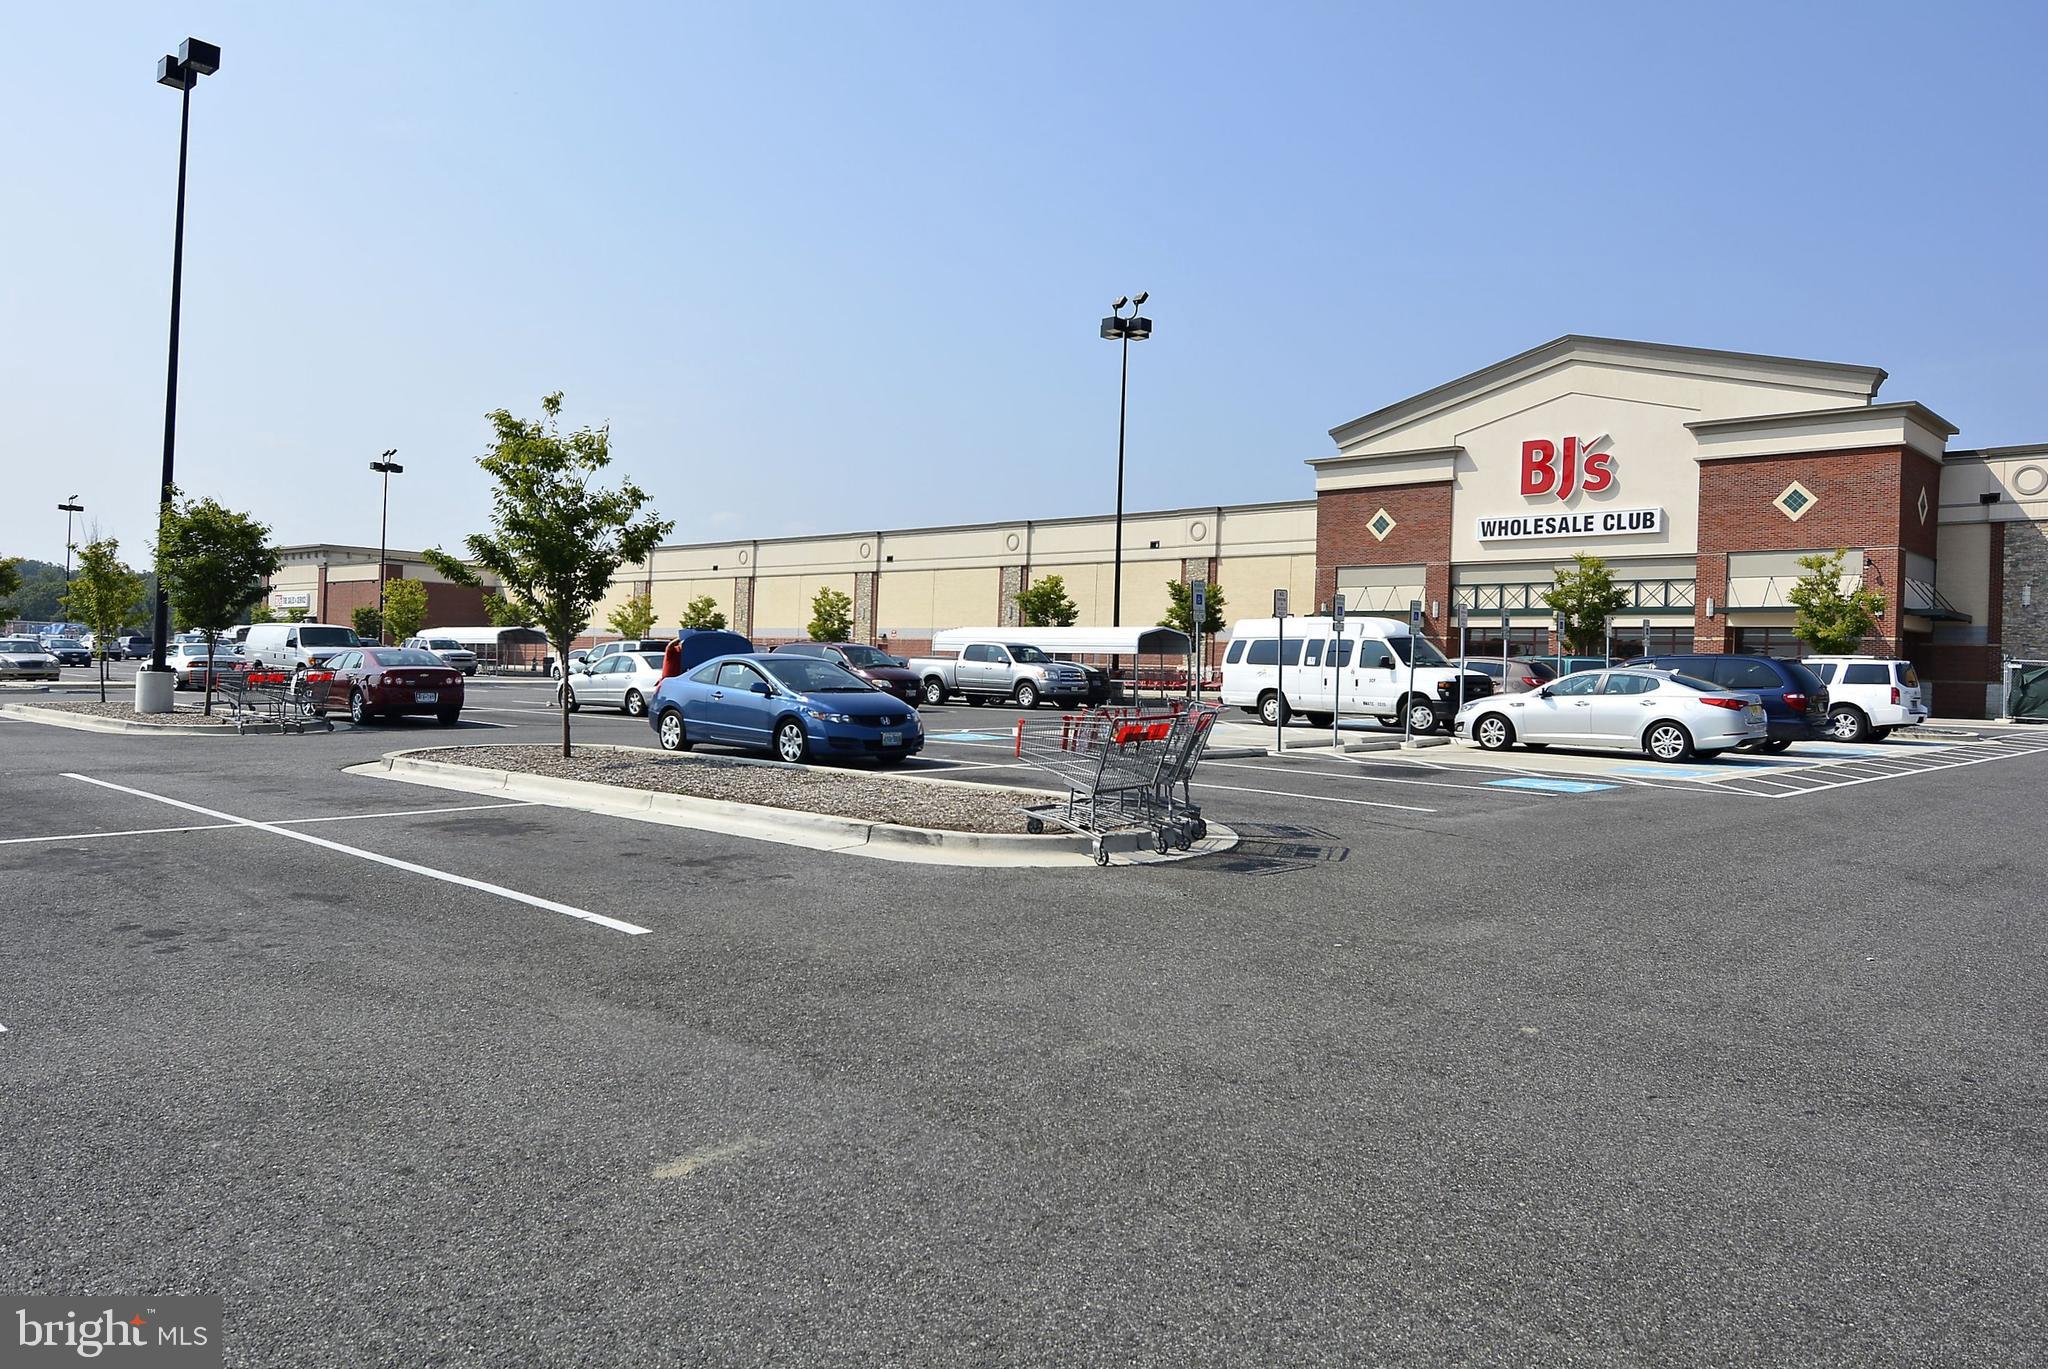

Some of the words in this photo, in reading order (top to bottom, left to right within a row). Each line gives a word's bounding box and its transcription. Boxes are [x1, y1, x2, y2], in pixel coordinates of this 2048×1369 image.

[1520, 435, 1612, 501] BJ's
[1480, 515, 1595, 537] WHOLESALE
[1602, 511, 1655, 531] CLUB
